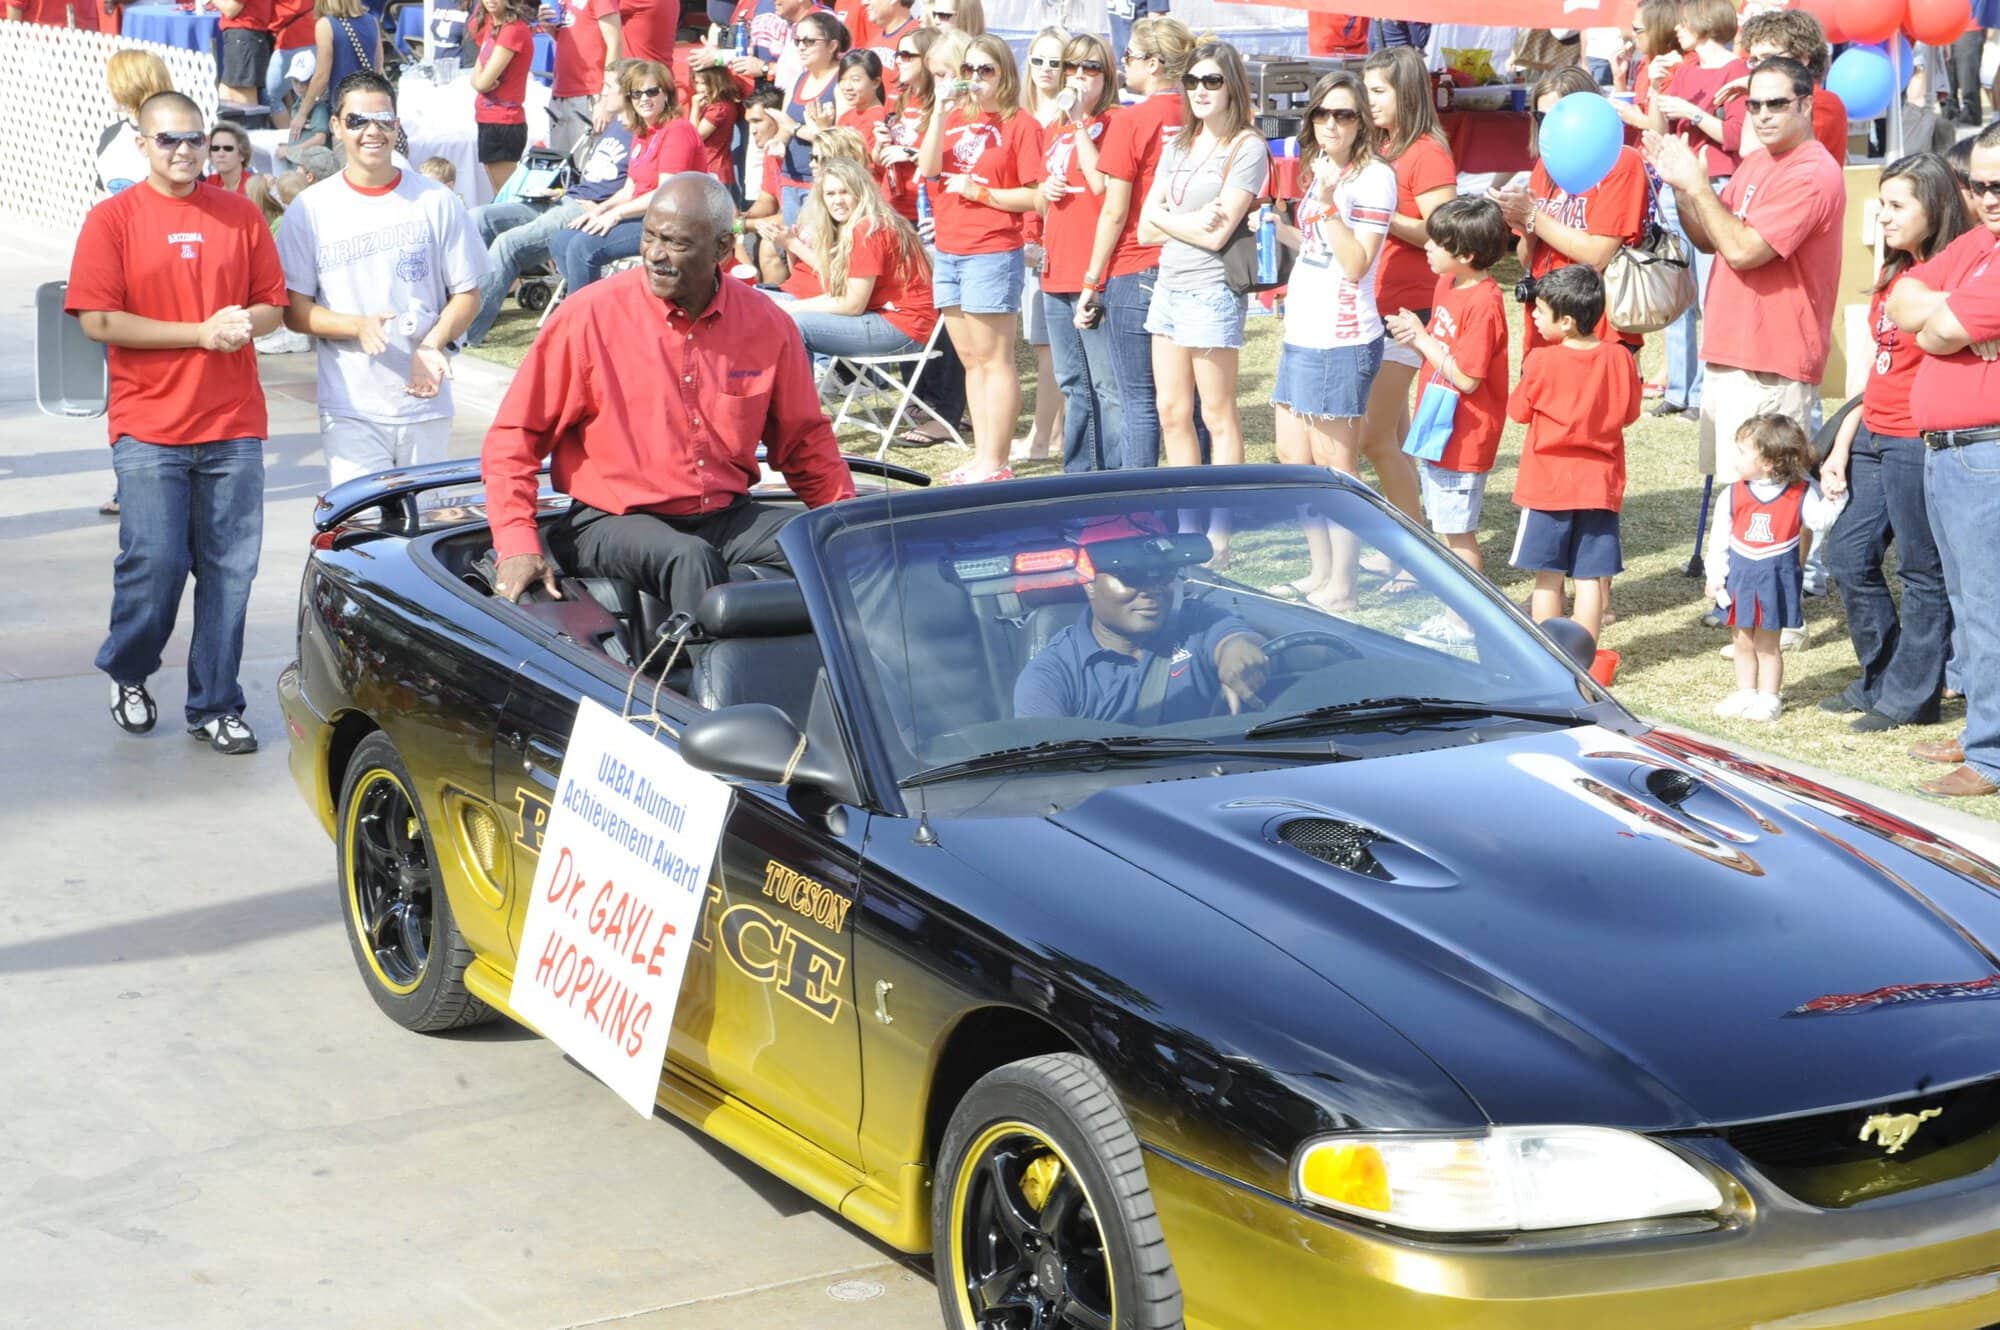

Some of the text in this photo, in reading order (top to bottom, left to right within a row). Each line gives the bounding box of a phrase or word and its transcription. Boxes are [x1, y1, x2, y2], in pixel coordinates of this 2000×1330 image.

[319, 220, 433, 274] ARIZONA
[1744, 512, 1774, 542] A
[598, 752, 688, 834] UABA Alumni
[562, 779, 701, 894] Achievement Award
[547, 847, 677, 976] Dr. GAYLE
[762, 859, 852, 934] TUCSON
[535, 930, 653, 1057] HOPKINS
